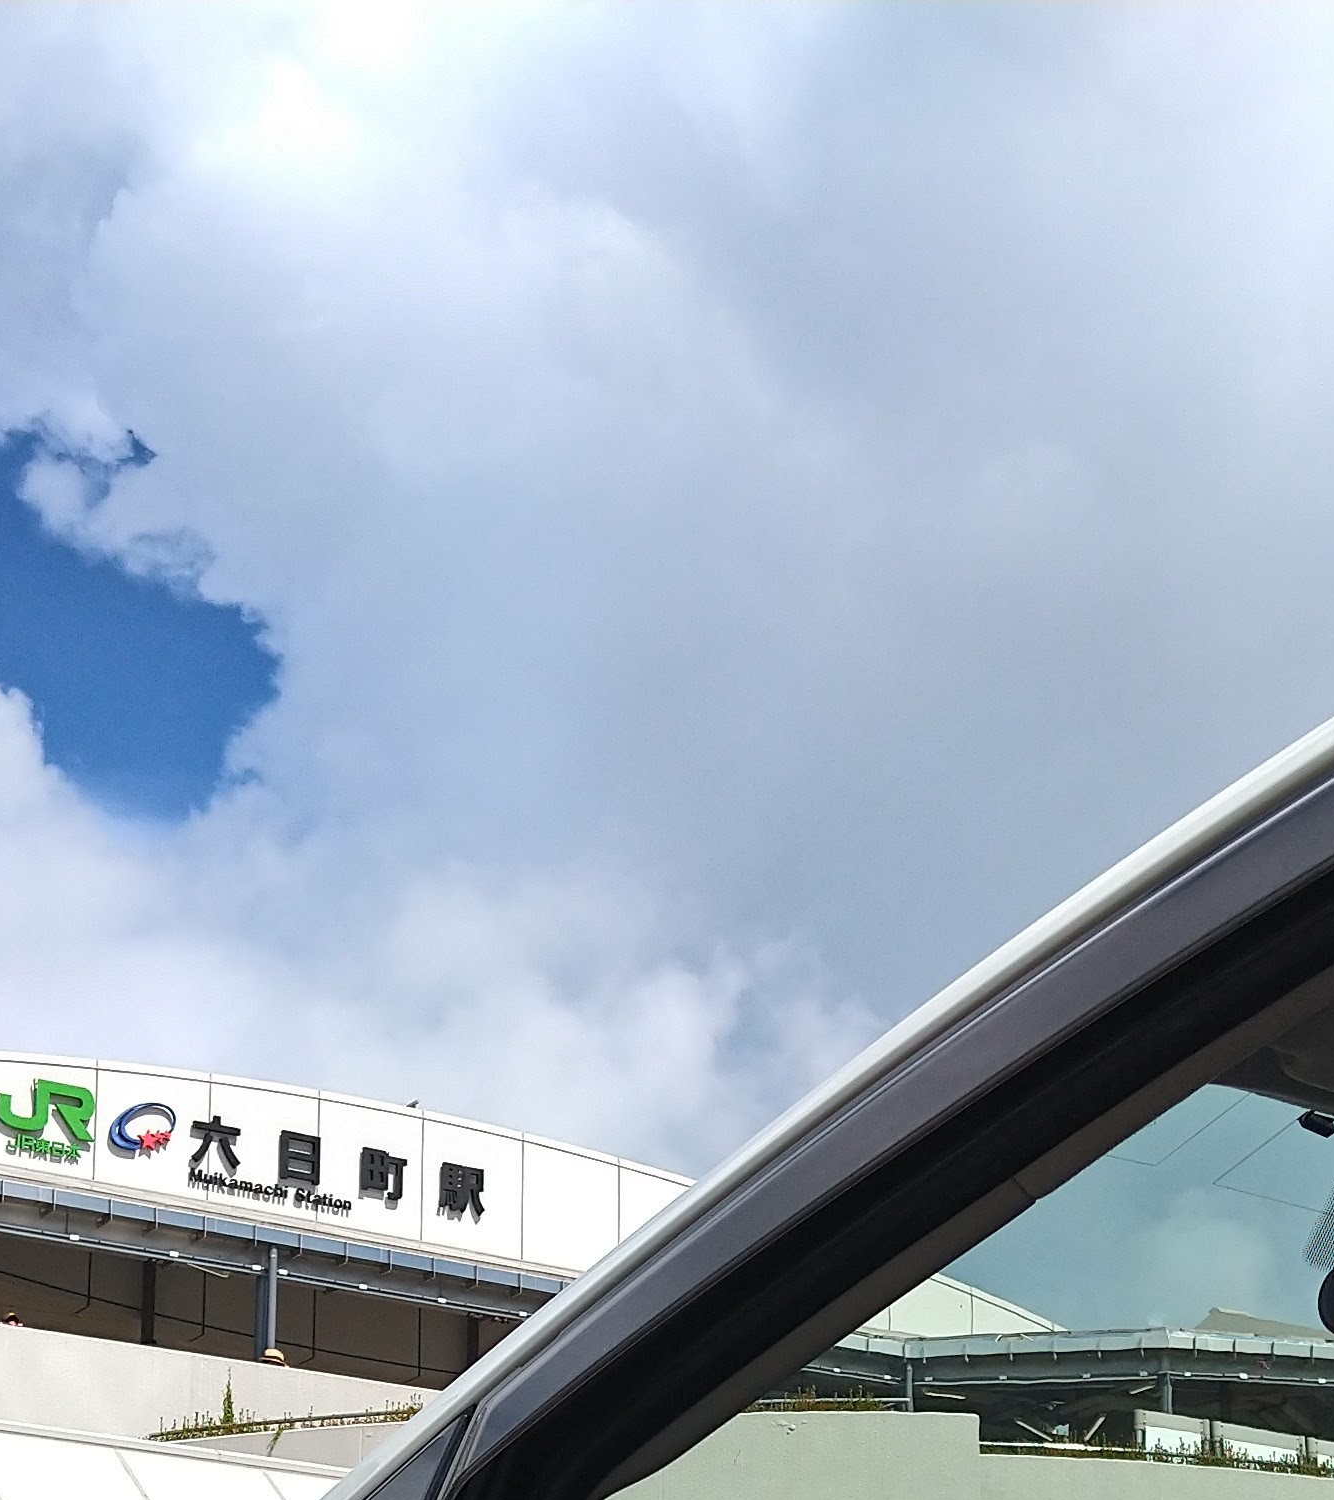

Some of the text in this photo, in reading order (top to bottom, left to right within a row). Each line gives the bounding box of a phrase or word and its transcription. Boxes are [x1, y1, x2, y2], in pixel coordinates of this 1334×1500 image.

[6, 1133, 82, 1159] JR東日本
[188, 1115, 486, 1218] 六日町駅
[187, 1167, 352, 1211] Muikamachi Station
